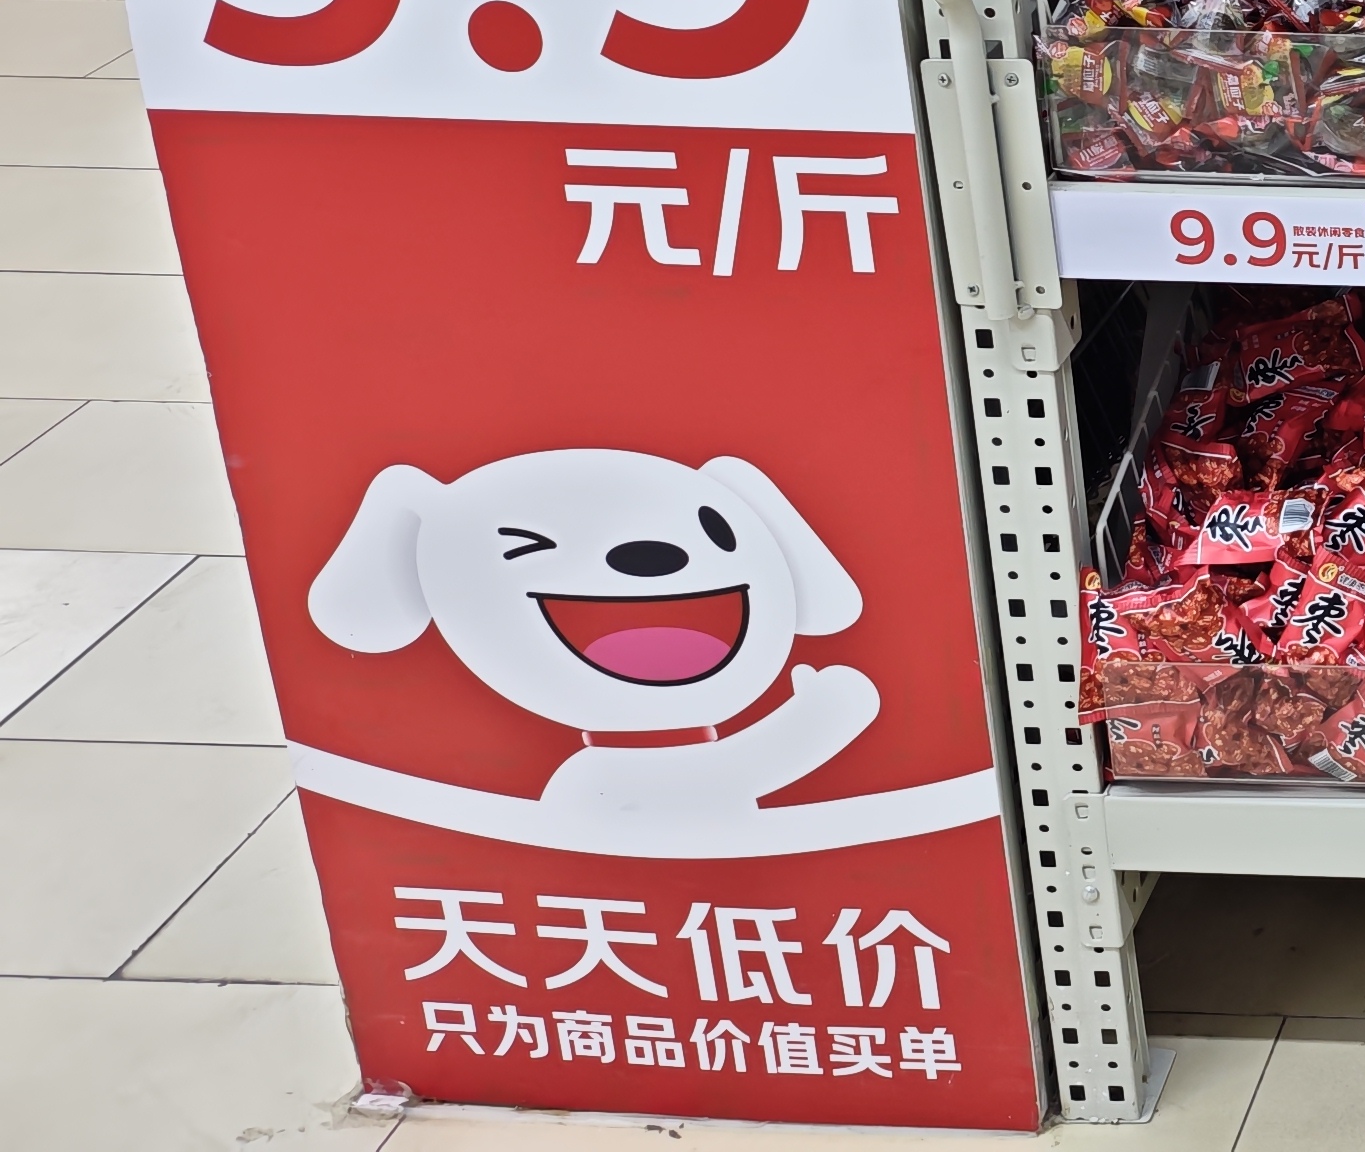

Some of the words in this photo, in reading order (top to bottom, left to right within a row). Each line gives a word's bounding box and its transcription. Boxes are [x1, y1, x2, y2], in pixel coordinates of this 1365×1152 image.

[564, 148, 899, 276] 元/斤
[1171, 210, 1286, 267] 9.9
[1292, 225, 1365, 239] 散装休闲零食
[1292, 243, 1365, 270] 元/斤
[394, 886, 951, 1010] 天天低价
[422, 1001, 961, 1080] 只为商品价值买单
